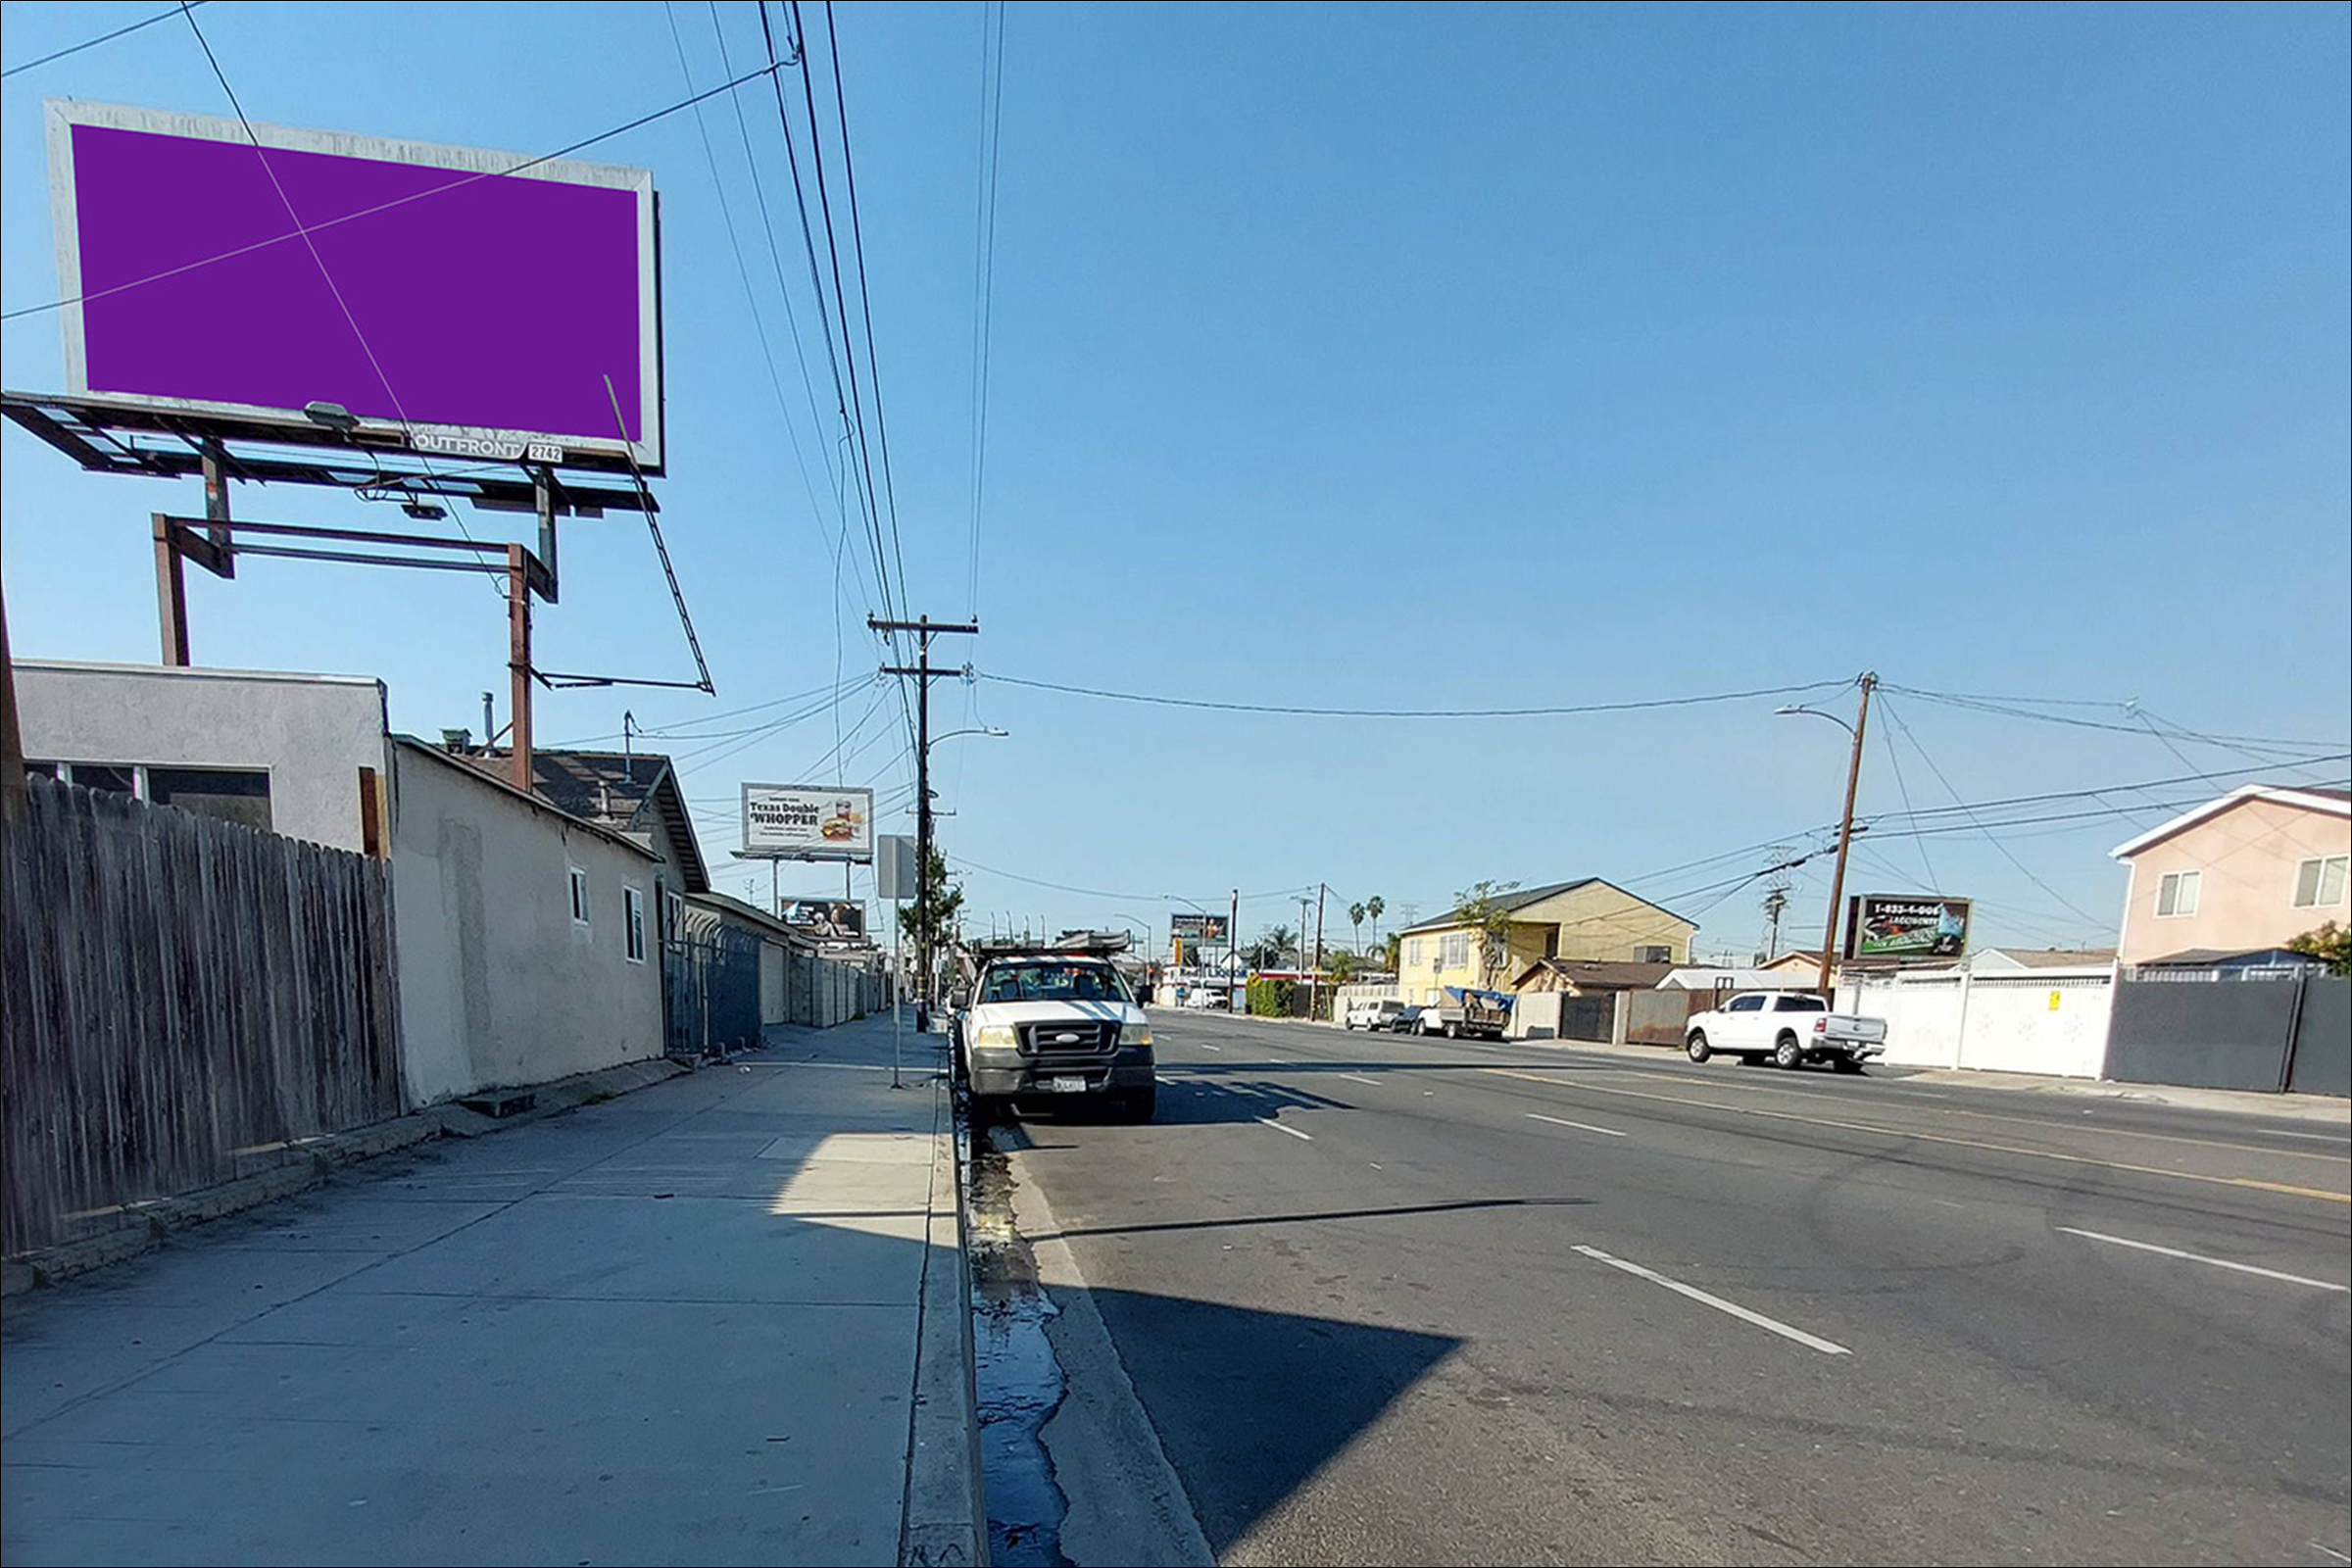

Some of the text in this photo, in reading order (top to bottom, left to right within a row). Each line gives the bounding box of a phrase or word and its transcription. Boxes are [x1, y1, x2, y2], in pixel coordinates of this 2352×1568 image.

[416, 435, 520, 456] OUTFRONT
[530, 445, 561, 461] 2742
[750, 802, 819, 814] Texas Double
[750, 812, 818, 825] WHOPPER
